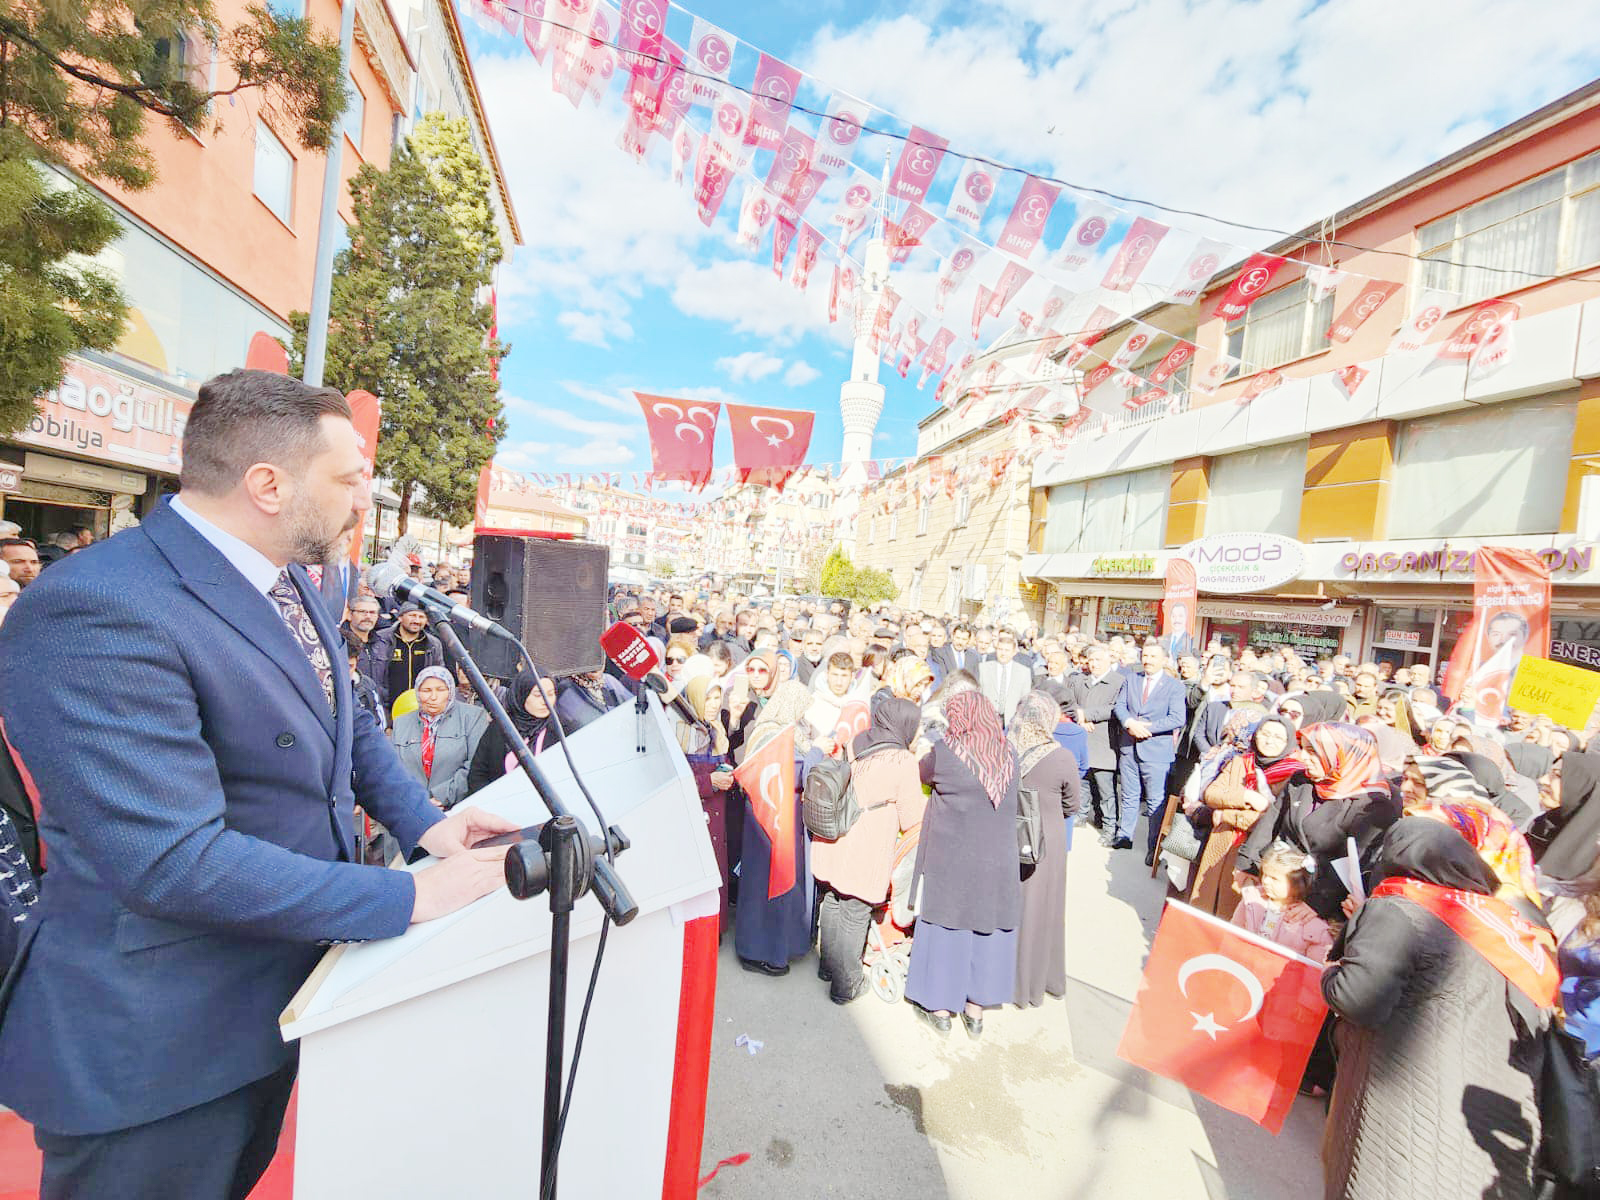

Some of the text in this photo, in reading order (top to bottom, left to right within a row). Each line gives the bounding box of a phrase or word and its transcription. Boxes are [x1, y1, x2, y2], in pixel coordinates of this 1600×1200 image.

[692, 83, 720, 100] MHP
[753, 123, 781, 141] MHP
[819, 153, 846, 169] MHP
[896, 180, 923, 196] MHP
[956, 204, 980, 221] MHP
[1005, 234, 1032, 250] MHP
[1174, 289, 1197, 298] MHP
[1222, 303, 1247, 315] MHP
[29, 413, 104, 449] obilya
[1198, 542, 1283, 563] Moda
[1340, 546, 1595, 573] ORGANİZON
[1252, 564, 1260, 573] &
[1550, 640, 1600, 667] ENER
